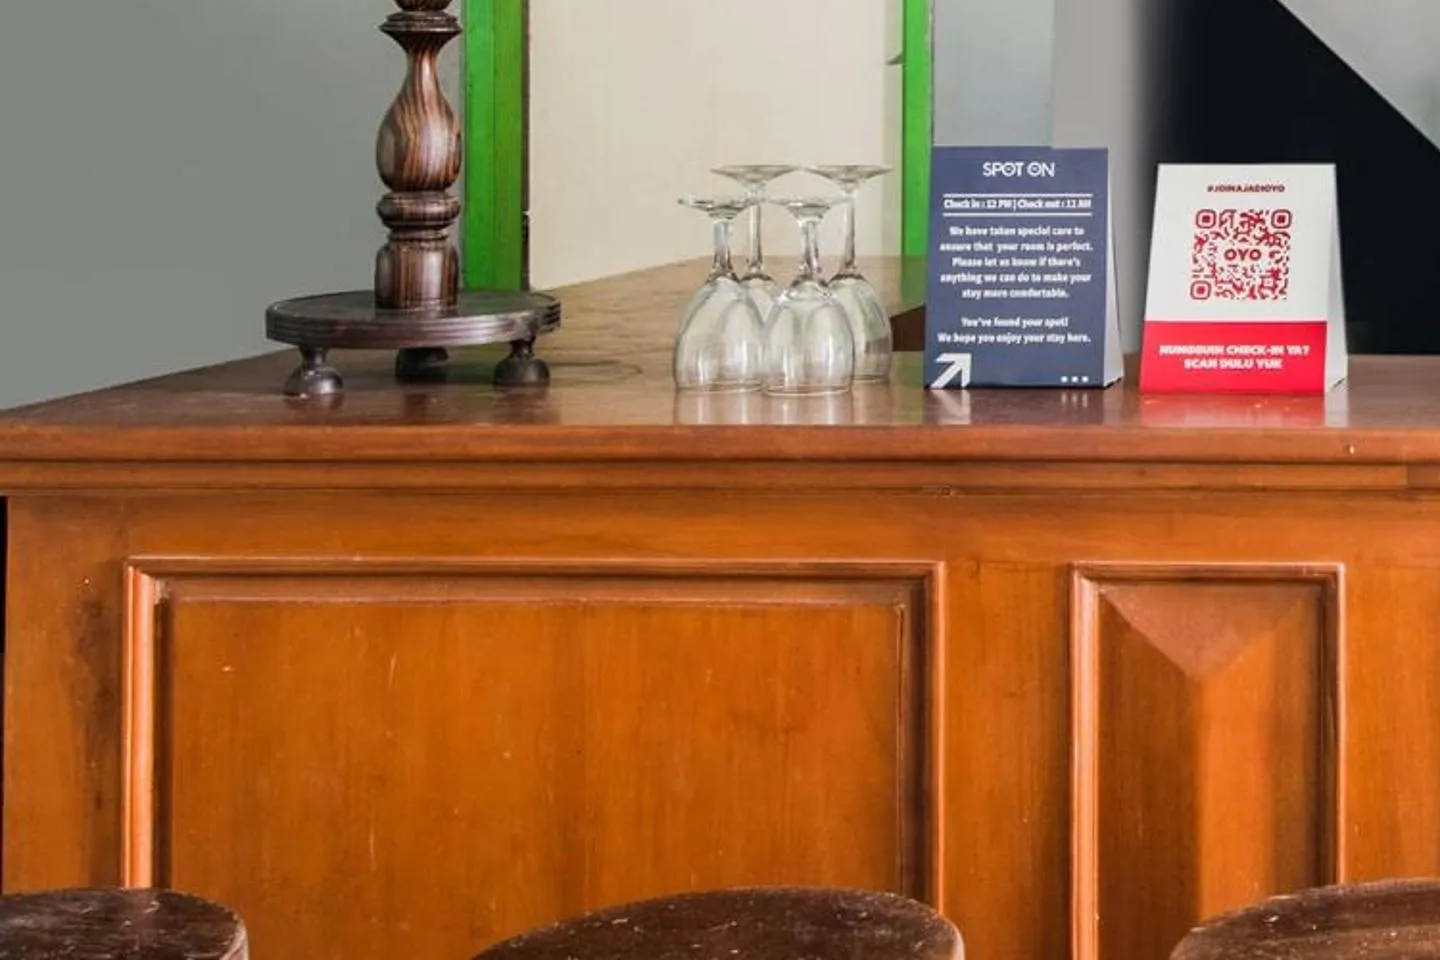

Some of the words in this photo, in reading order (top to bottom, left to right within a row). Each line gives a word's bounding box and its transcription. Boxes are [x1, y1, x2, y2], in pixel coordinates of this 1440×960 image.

[982, 162, 1022, 177] SPOT
[1028, 162, 1055, 177] ON
[944, 198, 969, 208] Check
[970, 198, 980, 208] in
[1017, 198, 1043, 208] Check
[950, 226, 963, 236] We
[966, 225, 988, 236] have
[991, 226, 1014, 236] taken
[1018, 225, 1050, 238] special
[1052, 227, 1072, 236] care
[1075, 226, 1084, 236] to
[940, 243, 971, 252] ensure
[974, 241, 992, 252] that
[997, 243, 1018, 254] your
[1021, 243, 1045, 252] room
[1047, 241, 1054, 251] is
[1056, 240, 1093, 253] perfect.
[952, 256, 982, 267] Please
[985, 257, 997, 267] let
[999, 258, 1010, 267] us
[1012, 257, 1037, 267] know
[1039, 255, 1045, 267] if
[1048, 256, 1080, 267] there's
[1224, 248, 1262, 261] OYO
[940, 271, 981, 285] anything
[984, 274, 996, 283] we
[999, 273, 1015, 283] can
[1018, 271, 1029, 283] do
[1032, 273, 1041, 283] to
[1044, 272, 1067, 282] make
[1070, 273, 1091, 285] your
[962, 288, 980, 300] stay
[983, 289, 1007, 298] more
[1010, 287, 1069, 298] comfortable.
[961, 317, 991, 328] You've
[994, 316, 1020, 327] found
[1022, 318, 1044, 329] your
[1045, 316, 1068, 329] spot!
[938, 332, 951, 343] We
[953, 332, 976, 344] hope
[978, 334, 994, 345] you
[997, 331, 1021, 345] enjoy
[1023, 333, 1044, 345] your
[1047, 333, 1065, 345] stay
[1068, 332, 1091, 343] here.
[1227, 344, 1285, 356] CHECK-IN
[1184, 358, 1218, 369] SCAN
[1220, 357, 1254, 370] DULU
